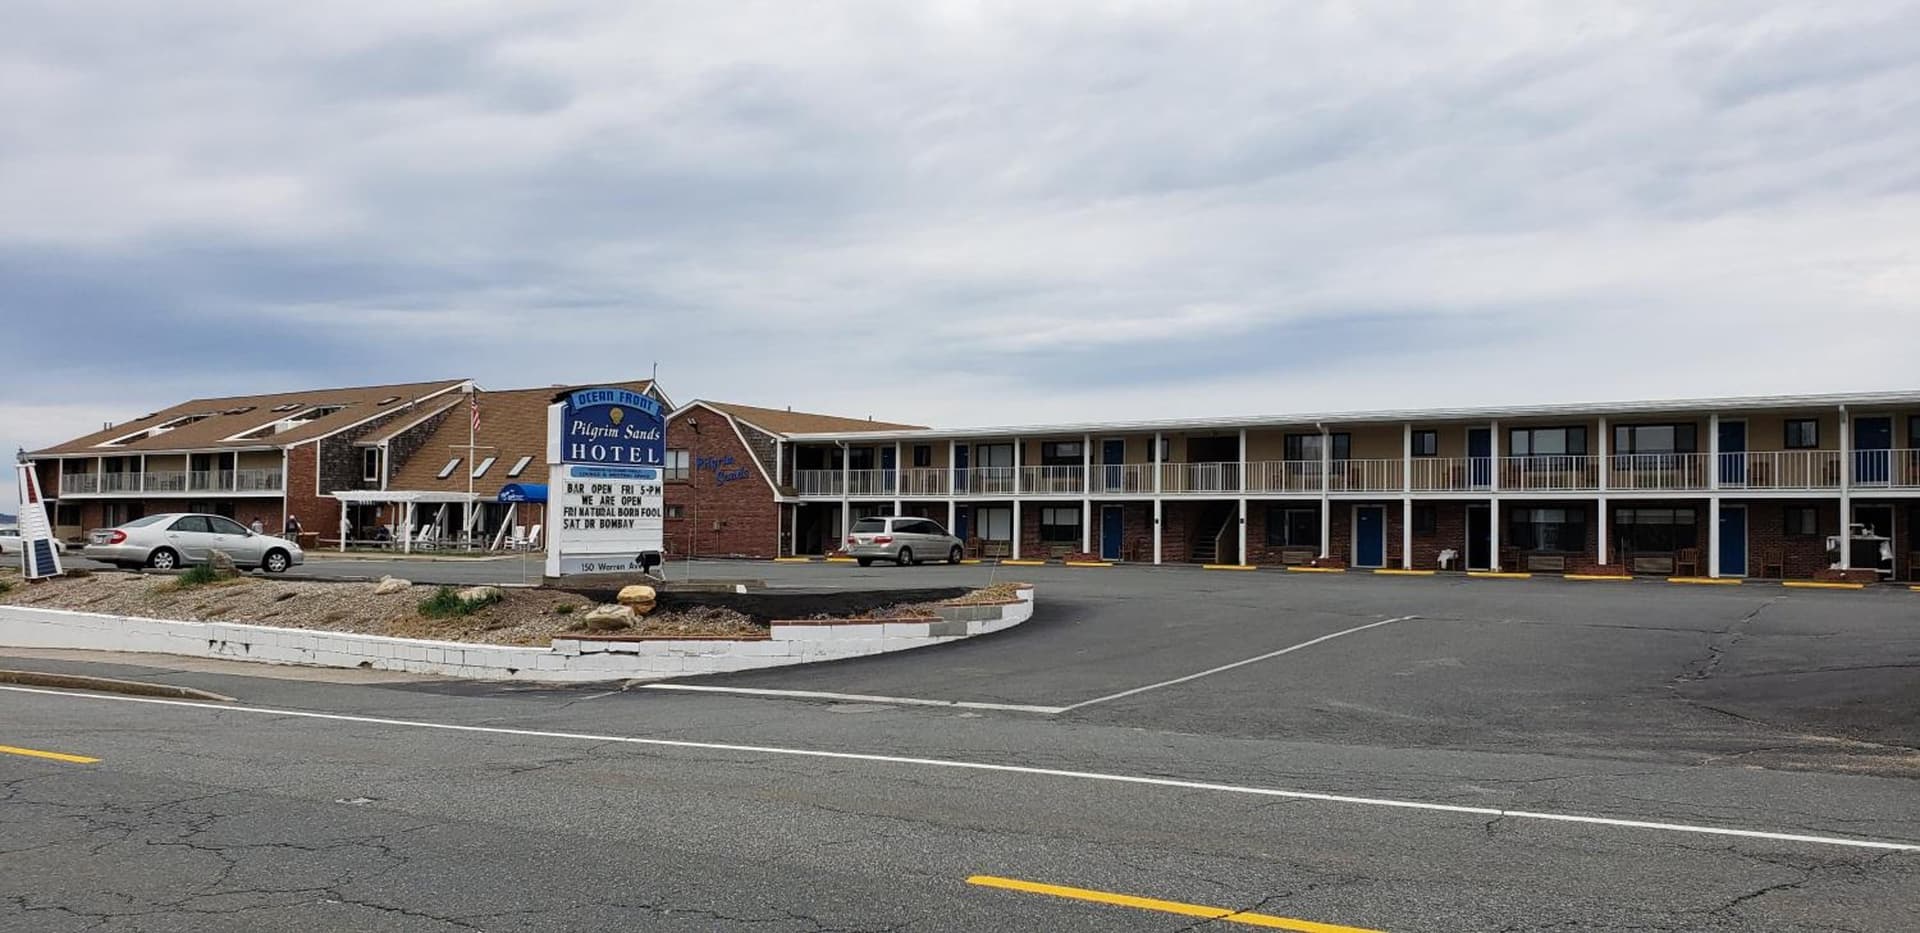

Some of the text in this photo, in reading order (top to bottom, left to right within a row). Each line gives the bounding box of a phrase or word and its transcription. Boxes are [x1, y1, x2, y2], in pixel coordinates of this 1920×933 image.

[578, 390, 653, 410] OCEAN FRONT
[571, 420, 661, 442] Pilgrim Sands
[571, 443, 660, 463] HOTEL
[567, 483, 584, 494] BAR
[591, 484, 612, 494] OPEN
[621, 484, 634, 495] FRI
[581, 495, 642, 505] WE ARE OPEN
[563, 507, 661, 517] FRI NATURAL BORN FOOL
[563, 519, 635, 529] SAT DR BOMBAY
[581, 563, 594, 572] 150
[598, 562, 625, 571] Warren
